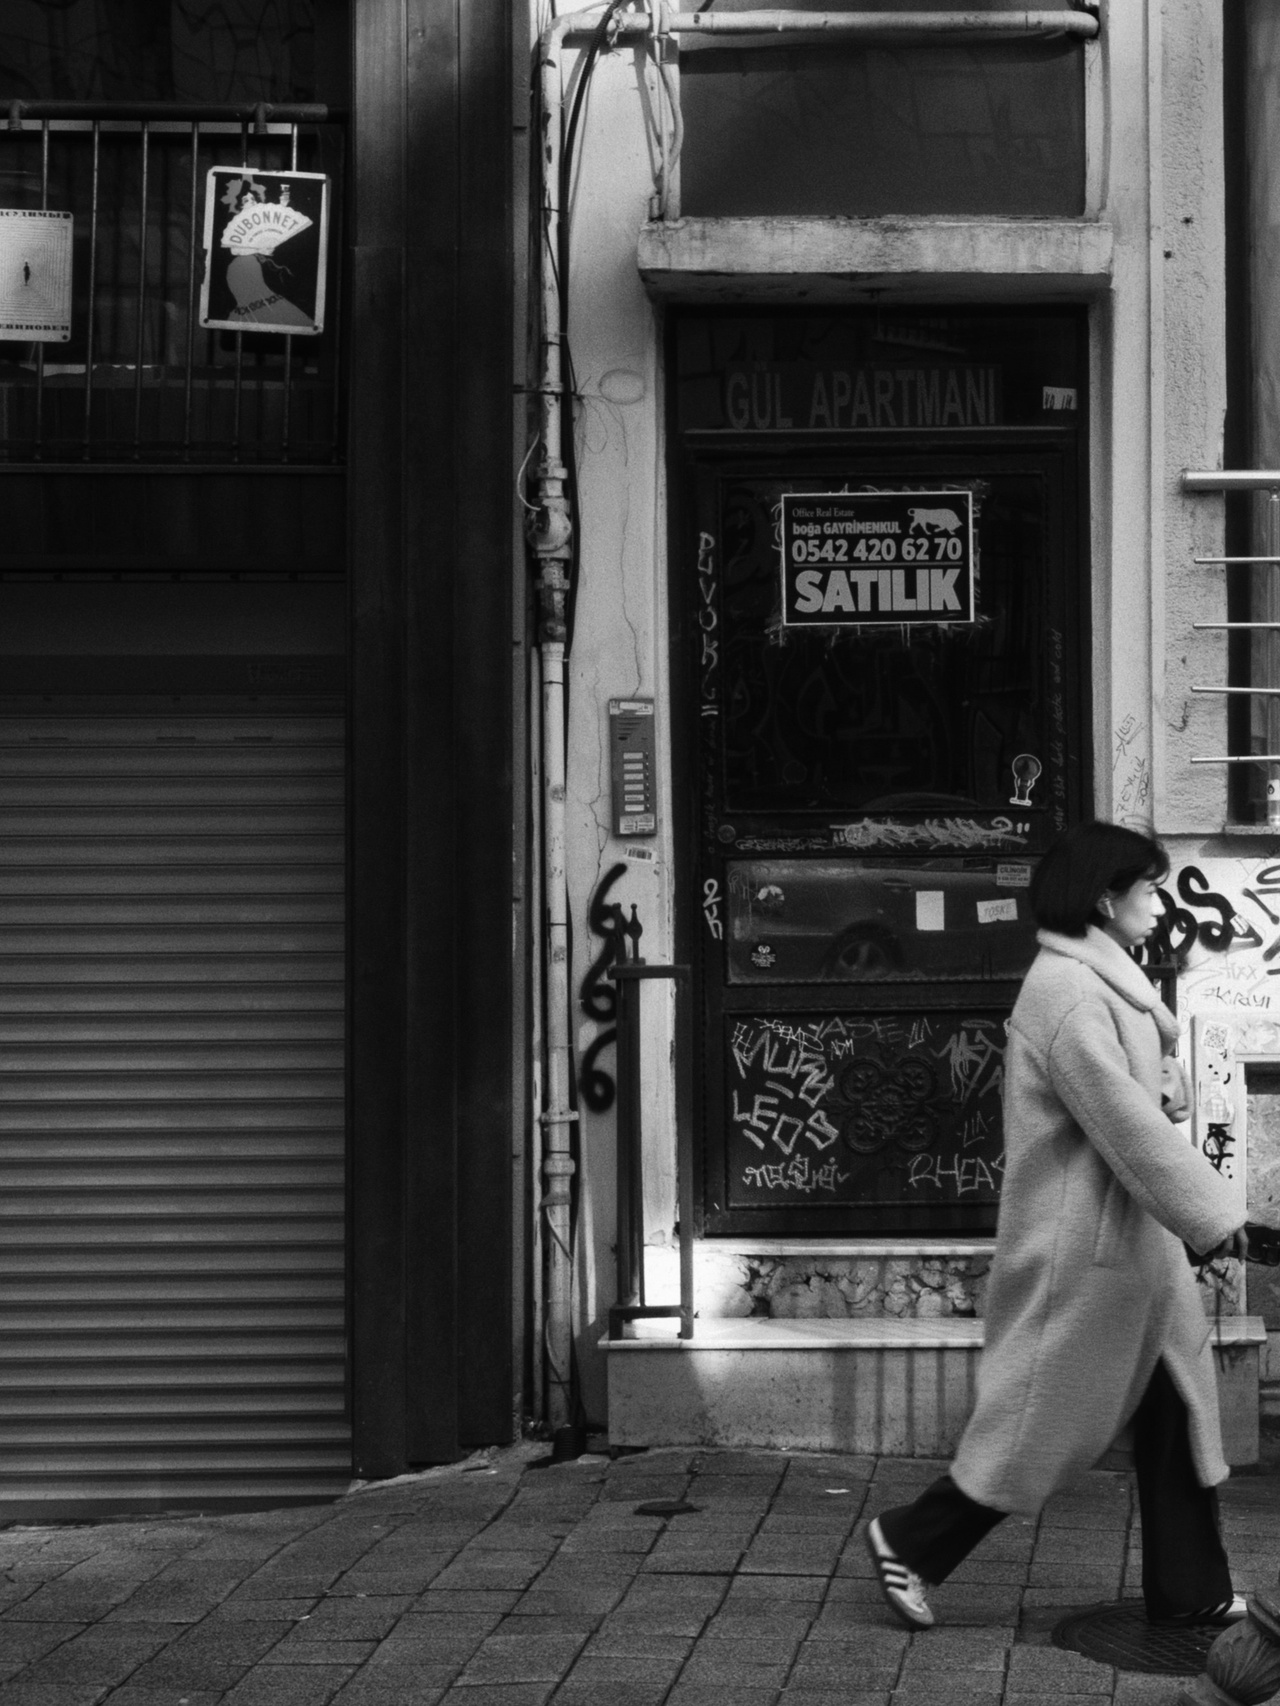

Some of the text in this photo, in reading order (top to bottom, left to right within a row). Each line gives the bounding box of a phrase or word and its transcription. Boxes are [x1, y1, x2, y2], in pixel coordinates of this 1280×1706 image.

[229, 210, 299, 245] DUBONNET
[726, 363, 997, 429] GÜL APARTMANI
[791, 506, 855, 518] Office Real Estate
[792, 518, 902, 537] boğa GAYRİMENKUL
[791, 537, 962, 562] 0542 420 62 70
[794, 568, 962, 614] SATILIK
